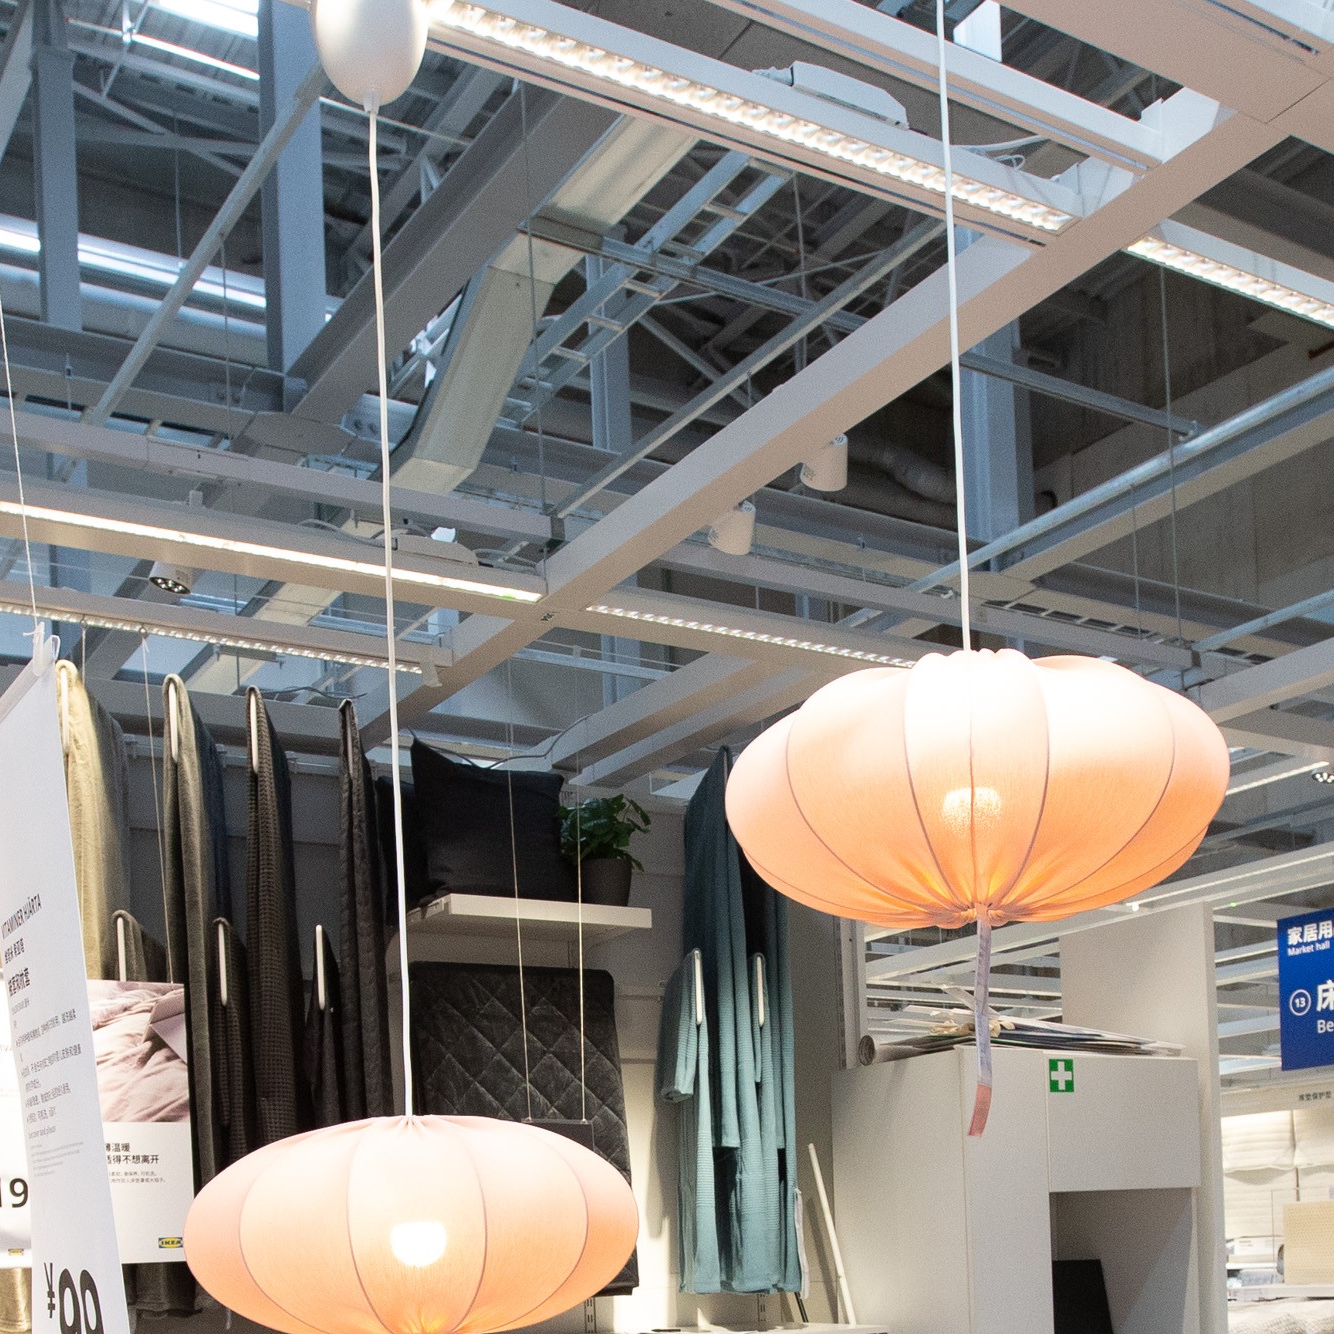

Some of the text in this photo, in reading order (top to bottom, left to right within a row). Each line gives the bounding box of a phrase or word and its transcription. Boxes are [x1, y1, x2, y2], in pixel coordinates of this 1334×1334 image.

[1287, 941, 1331, 956] Market hall
[1295, 997, 1306, 1008] 13
